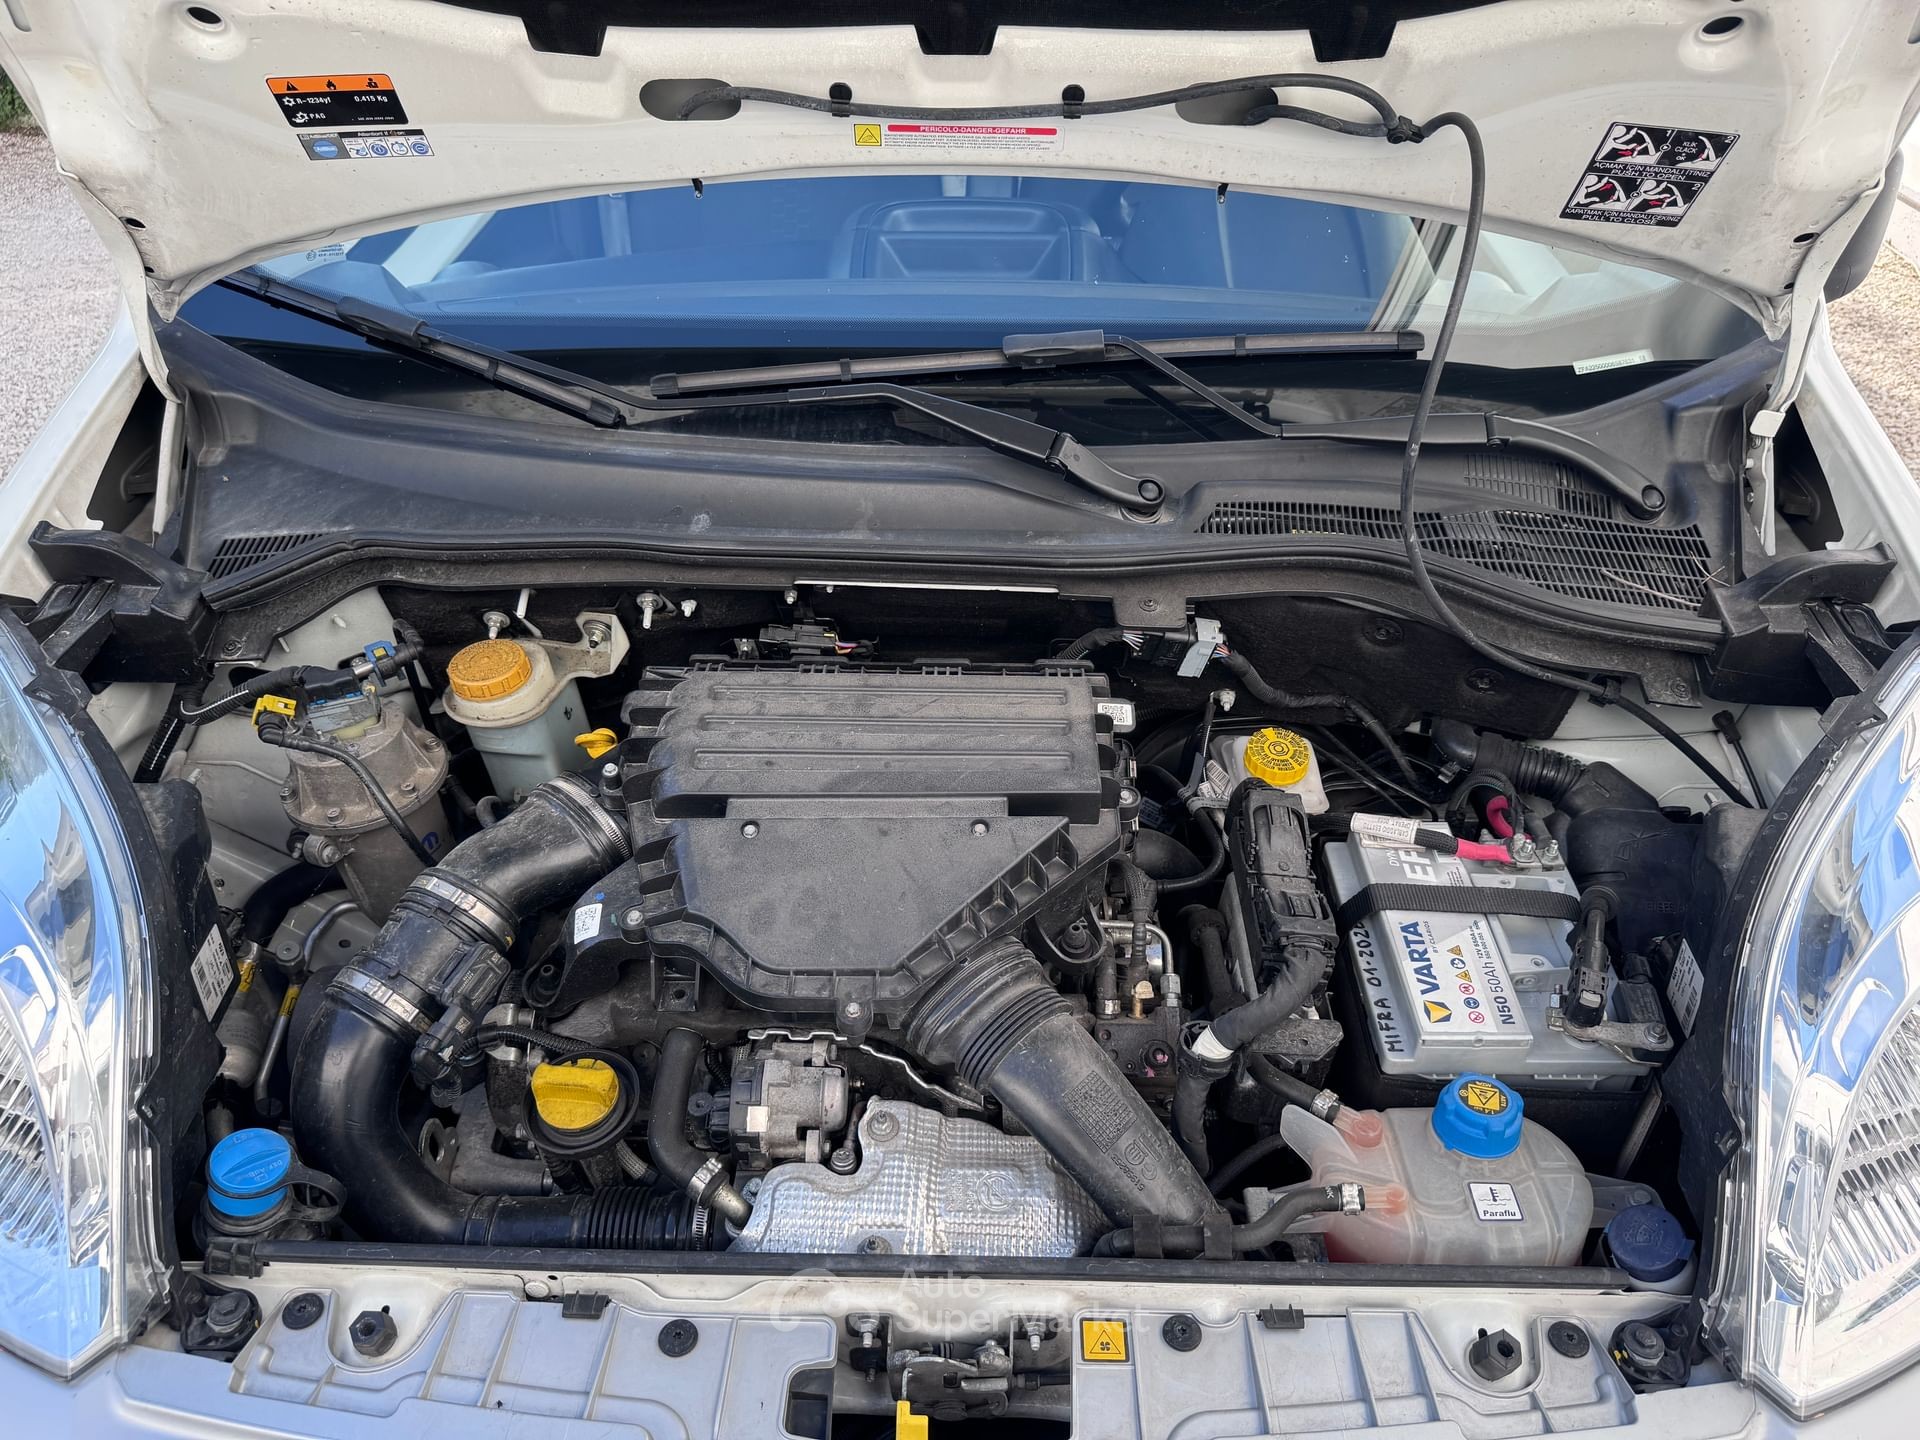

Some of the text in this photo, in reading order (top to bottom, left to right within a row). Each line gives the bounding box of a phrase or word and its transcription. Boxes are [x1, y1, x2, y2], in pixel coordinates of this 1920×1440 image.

[354, 95, 376, 103] 0.415
[920, 126, 1027, 135] PERICOLO-DANGER-GEFAHR
[1399, 849, 1437, 881] EF
[1400, 921, 1440, 995] VARTA
[1482, 962, 1516, 1025] N50 50Ah
[1374, 998, 1405, 1052] MIFRA
[1483, 1209, 1517, 1217] Paraflu
